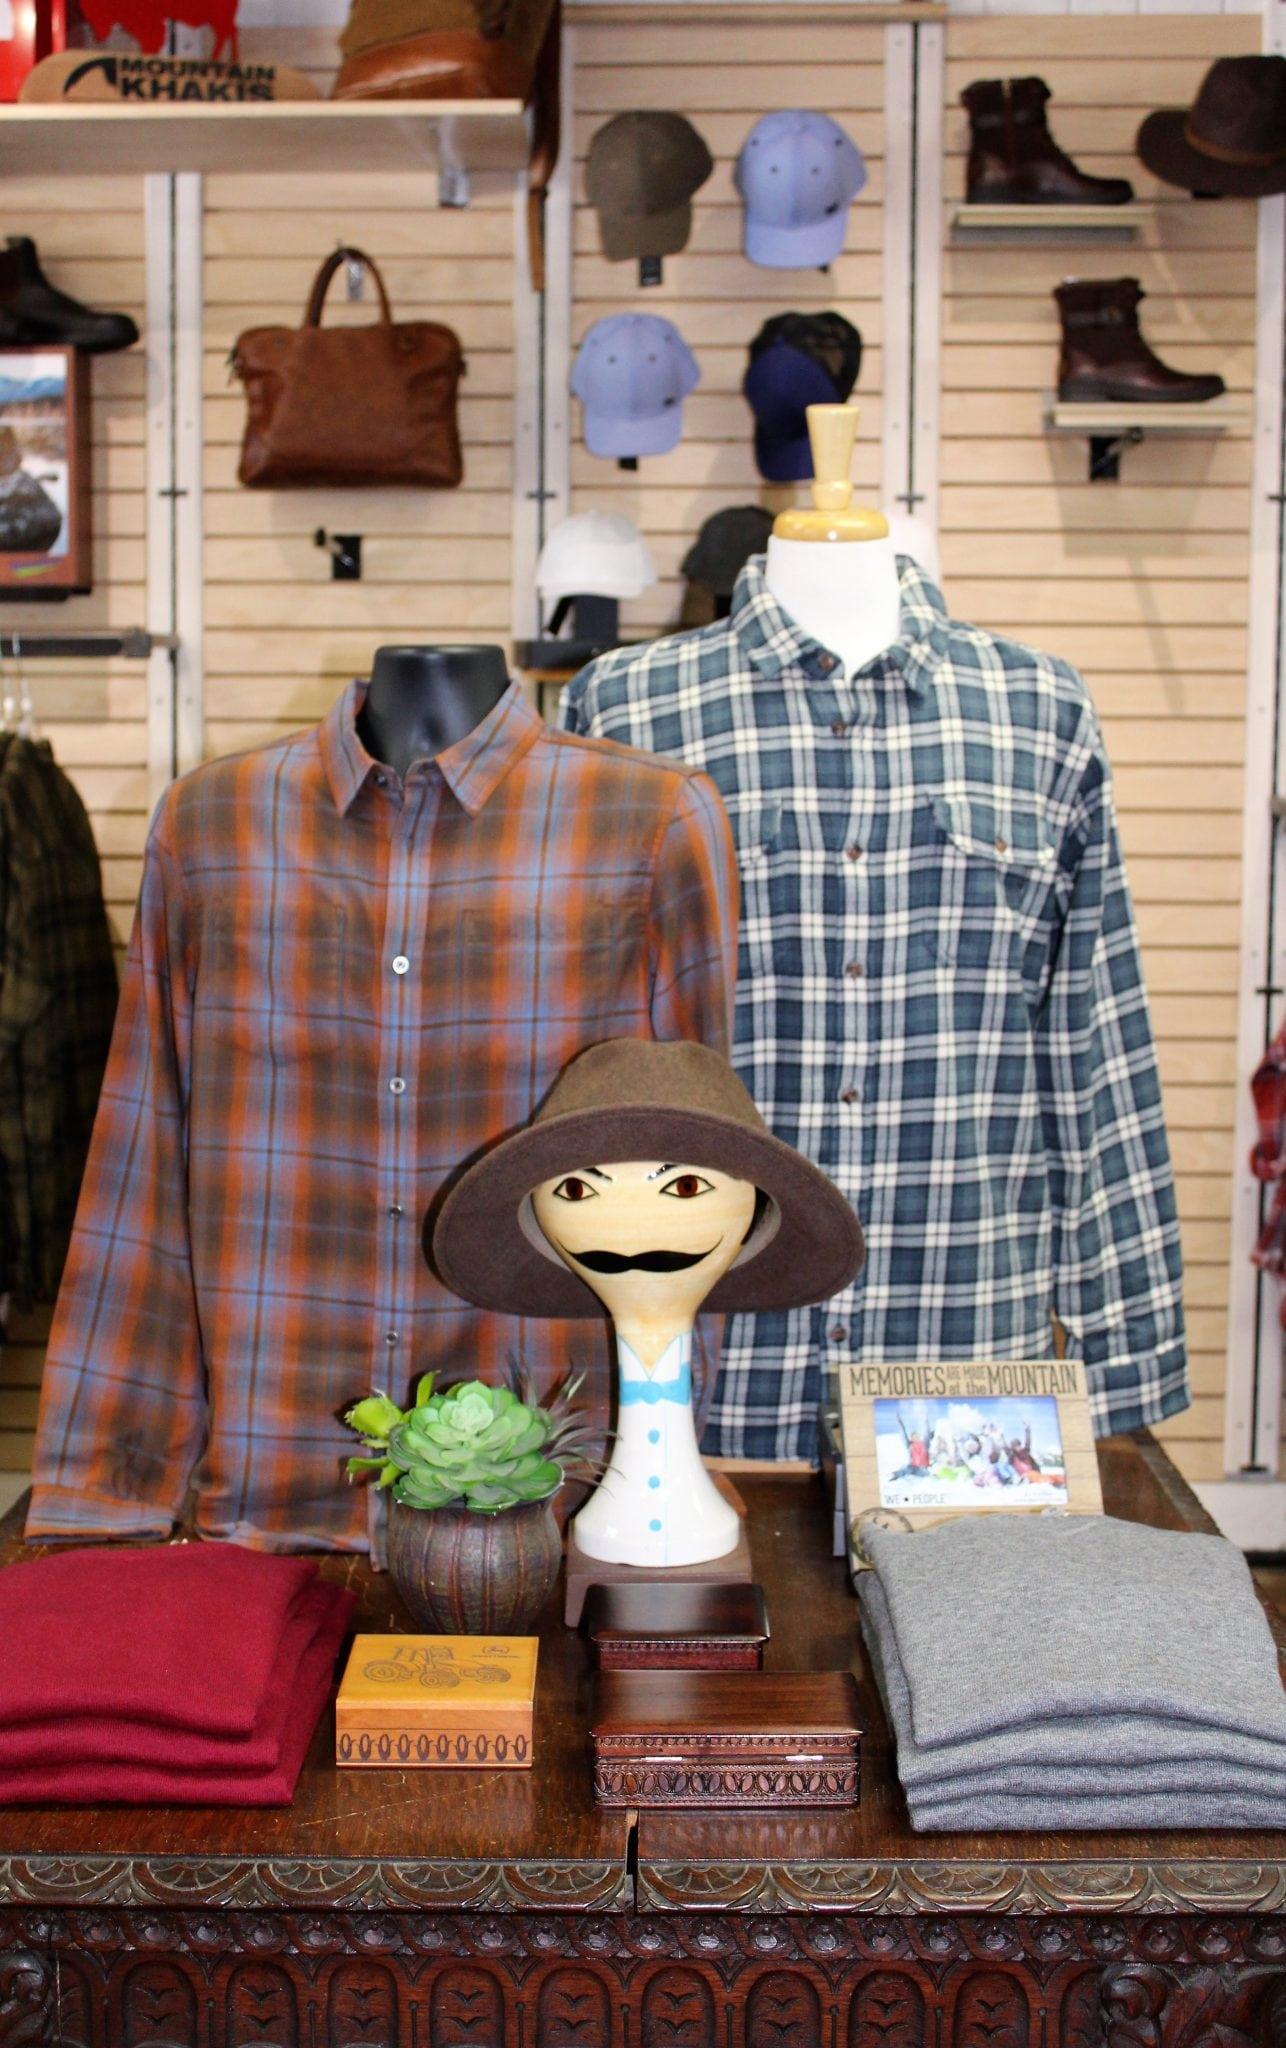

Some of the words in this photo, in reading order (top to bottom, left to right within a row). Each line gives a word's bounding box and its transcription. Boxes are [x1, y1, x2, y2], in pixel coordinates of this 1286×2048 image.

[121, 58, 275, 80] MOUNTAIN
[121, 77, 276, 101] KHAKIS
[850, 1365, 946, 1396] MEMORIES
[966, 1380, 987, 1396] the
[987, 1364, 1078, 1395] MOUNTAIN
[885, 1494, 900, 1505] WE
